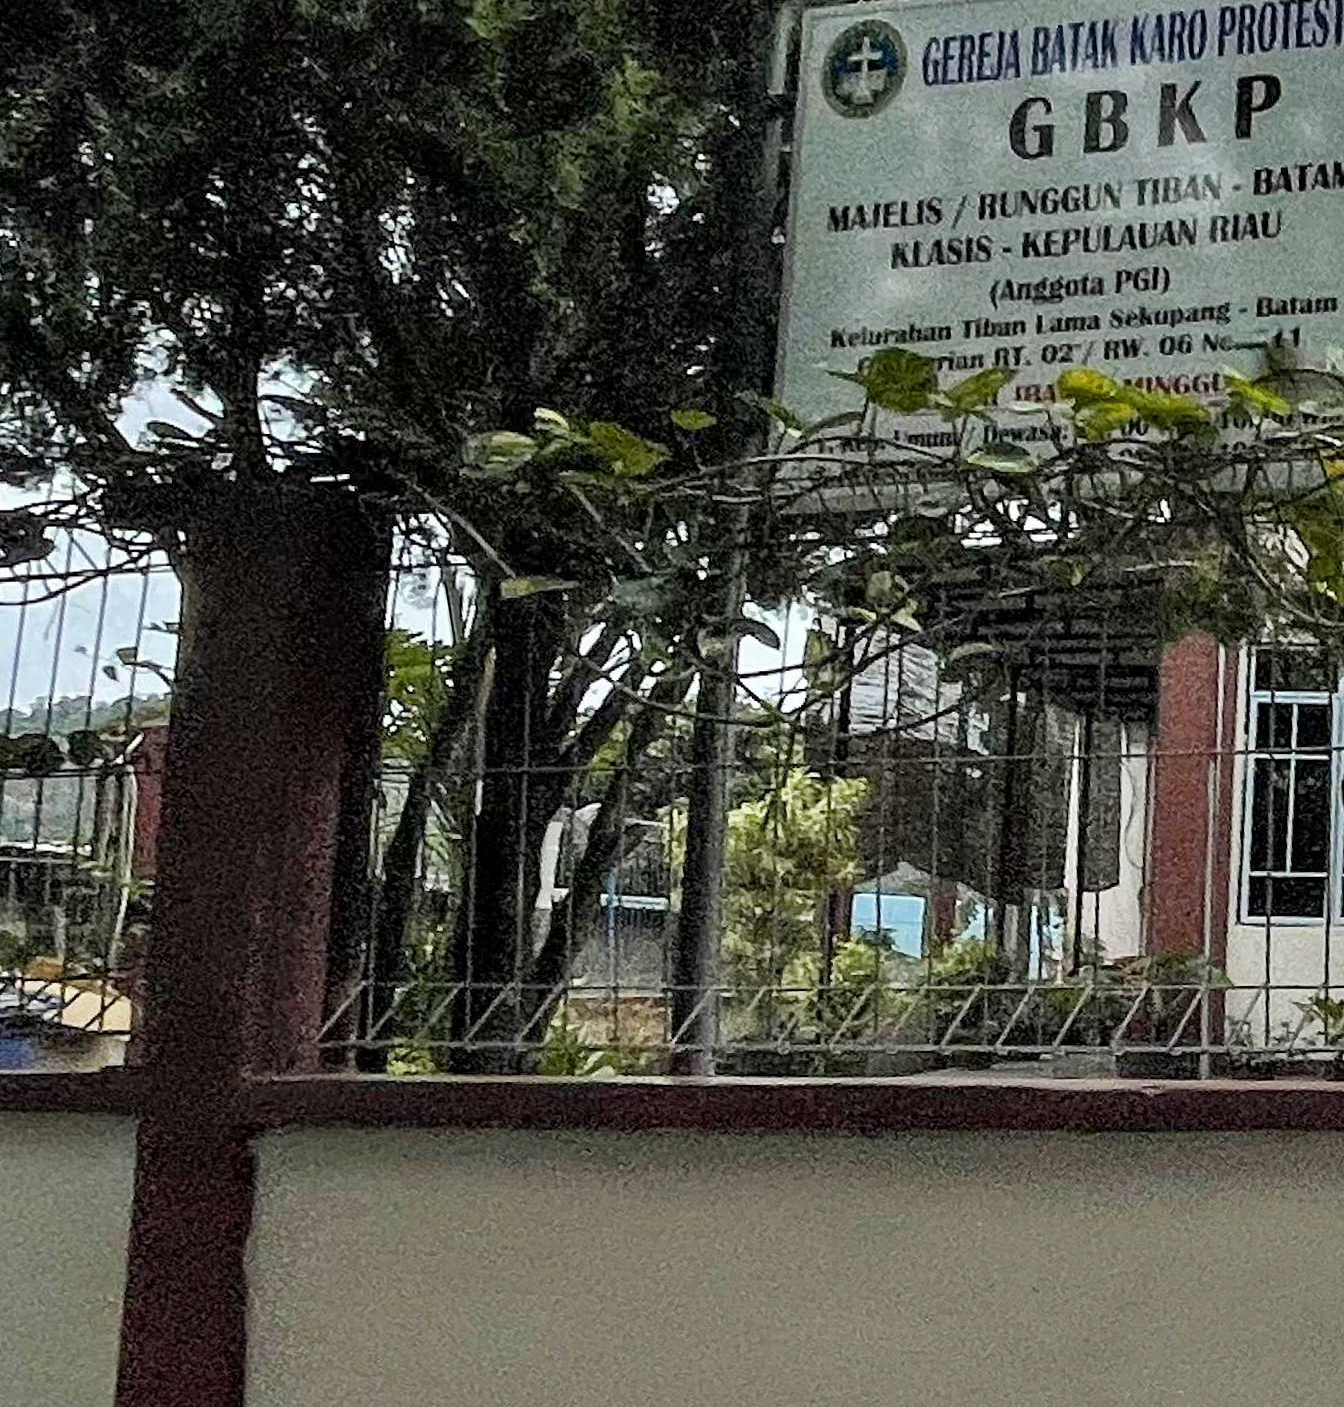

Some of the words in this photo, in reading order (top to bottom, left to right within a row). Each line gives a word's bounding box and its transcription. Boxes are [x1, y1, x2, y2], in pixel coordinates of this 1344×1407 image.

[921, 29, 1021, 86] GEREJA
[1031, 19, 1119, 76] BATAK
[1130, 7, 1208, 66] KARO
[827, 196, 943, 233] MAJELIS
[977, 181, 1122, 221] RUNGGUN
[1135, 173, 1222, 207] TIBAN
[890, 234, 994, 269] KLASIS
[1021, 218, 1197, 259] KEPULAUAN
[1208, 209, 1283, 243] RIAU
[989, 274, 1105, 311] (Anggota
[1114, 266, 1171, 294] PGI)
[829, 323, 952, 348] Kelurahan
[961, 317, 1027, 339] Tiban
[1035, 313, 1101, 335] Lama
[1108, 302, 1231, 329] Sekupang
[1255, 296, 1339, 318] Batam
[1040, 343, 1076, 366] 02
[1103, 337, 1150, 361] RW.
[1158, 333, 1193, 356] 06
